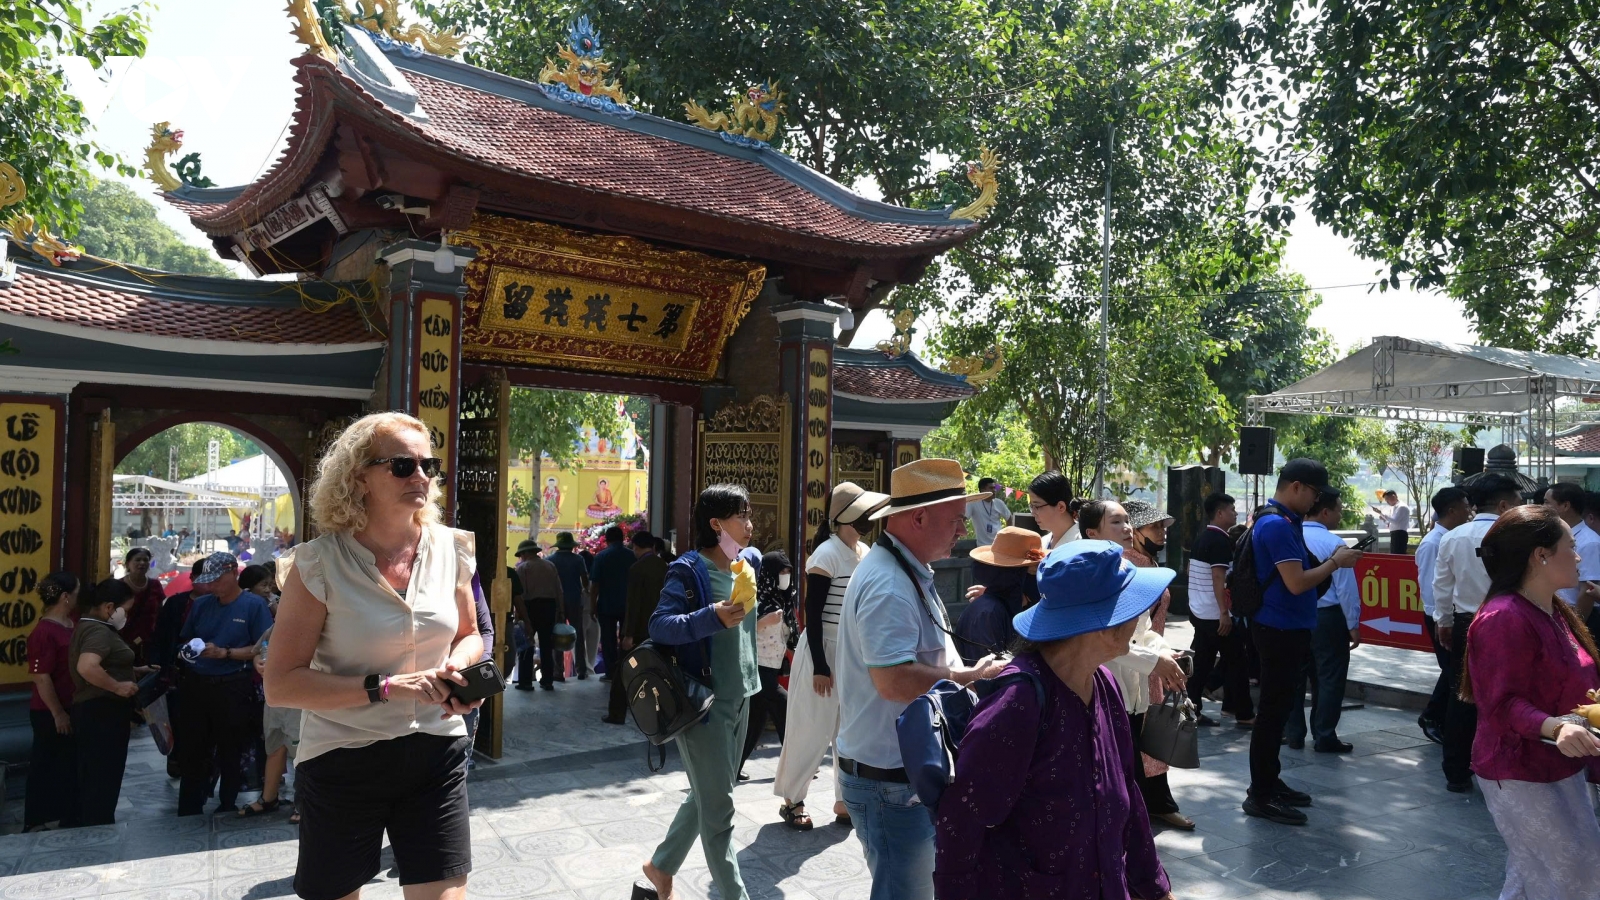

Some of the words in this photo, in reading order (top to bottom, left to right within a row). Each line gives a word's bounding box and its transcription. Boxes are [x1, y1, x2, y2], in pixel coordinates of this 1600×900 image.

[422, 314, 450, 337] TÂM
[421, 349, 449, 373] ĐỨC
[6, 412, 41, 442] LỄ
[808, 417, 828, 439] TÍCH
[1, 447, 41, 481] HỘI
[808, 449, 824, 469] TỤ
[0, 486, 42, 515] TƯNG
[807, 479, 826, 499] NGÀN
[0, 523, 44, 555] BỪNG
[0, 566, 38, 594] ƠN
[1361, 565, 1389, 609] ỐI
[0, 599, 37, 629] HÀO
[0, 634, 28, 666] KIỆ
